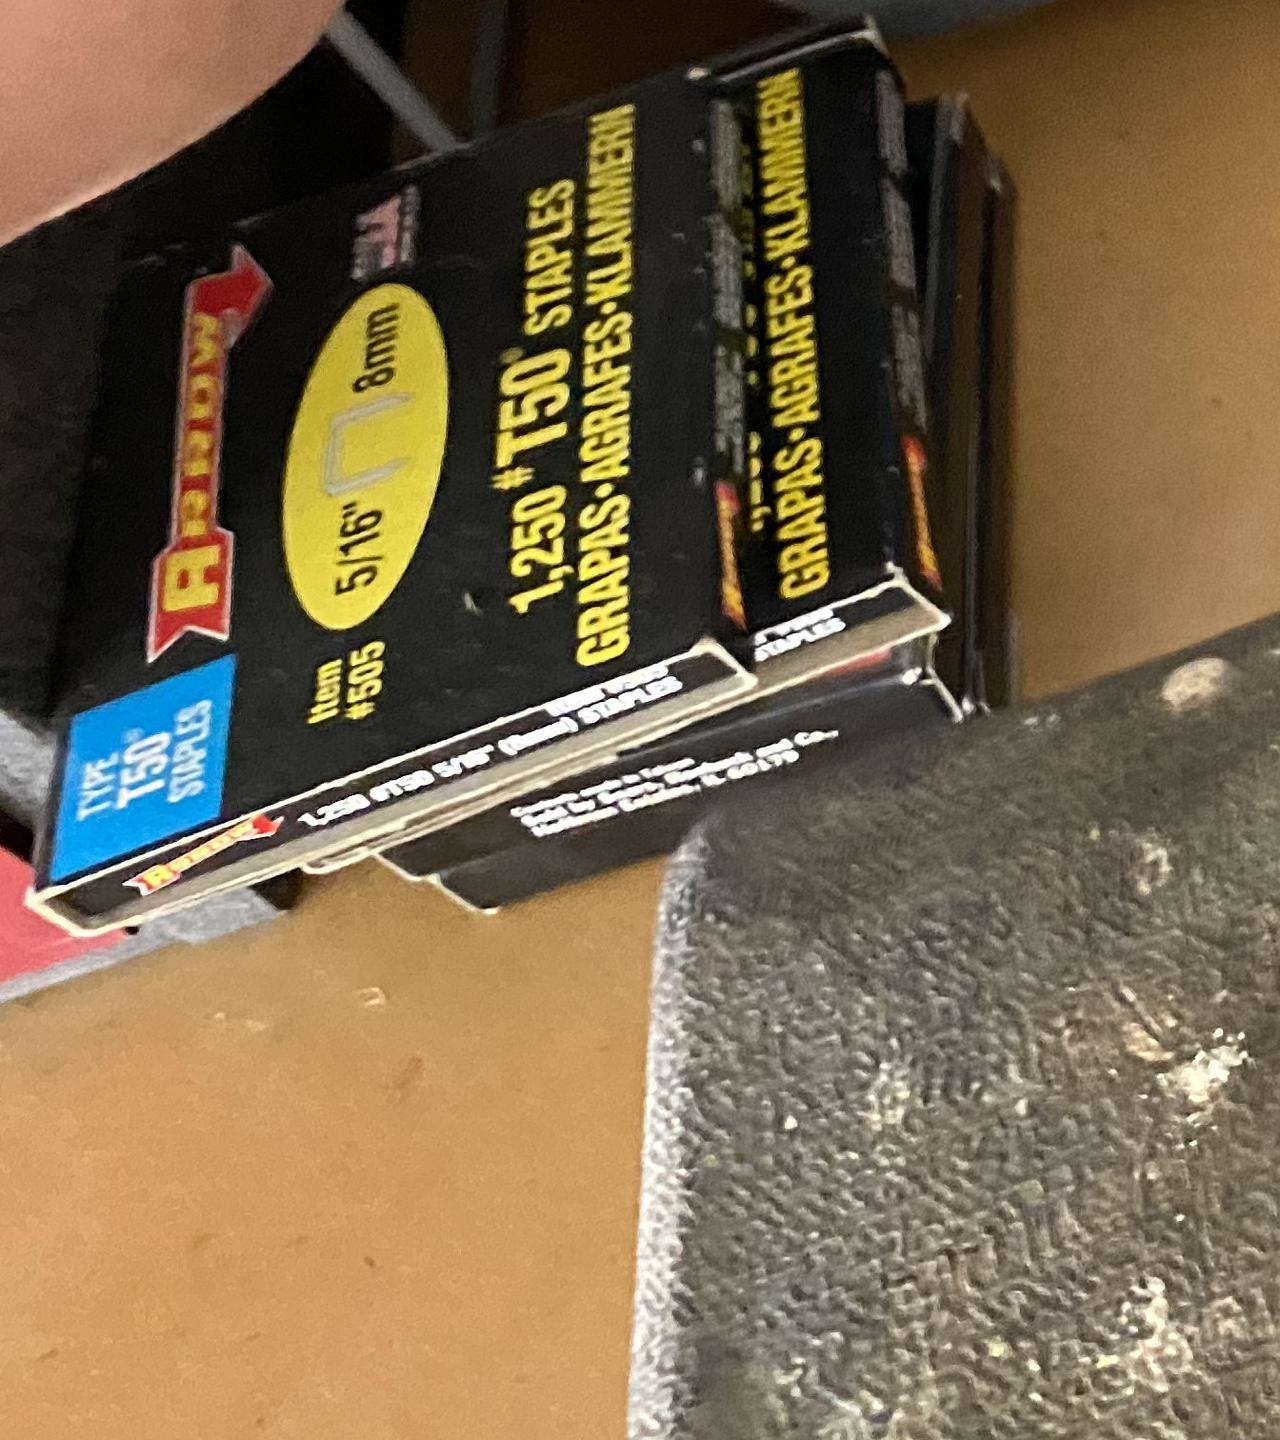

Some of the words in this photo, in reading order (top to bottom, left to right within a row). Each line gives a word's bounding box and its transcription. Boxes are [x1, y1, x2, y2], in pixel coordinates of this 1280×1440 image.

[522, 177, 577, 338] STAPLES
[352, 302, 401, 394] 8mm
[335, 501, 384, 597] 5/16"
[508, 483, 575, 616] 1,250
[307, 658, 343, 726] Item
[344, 638, 386, 721] #505
[578, 676, 683, 725] STAPLES
[76, 750, 119, 822] TYPE
[167, 699, 213, 803] STAPLES
